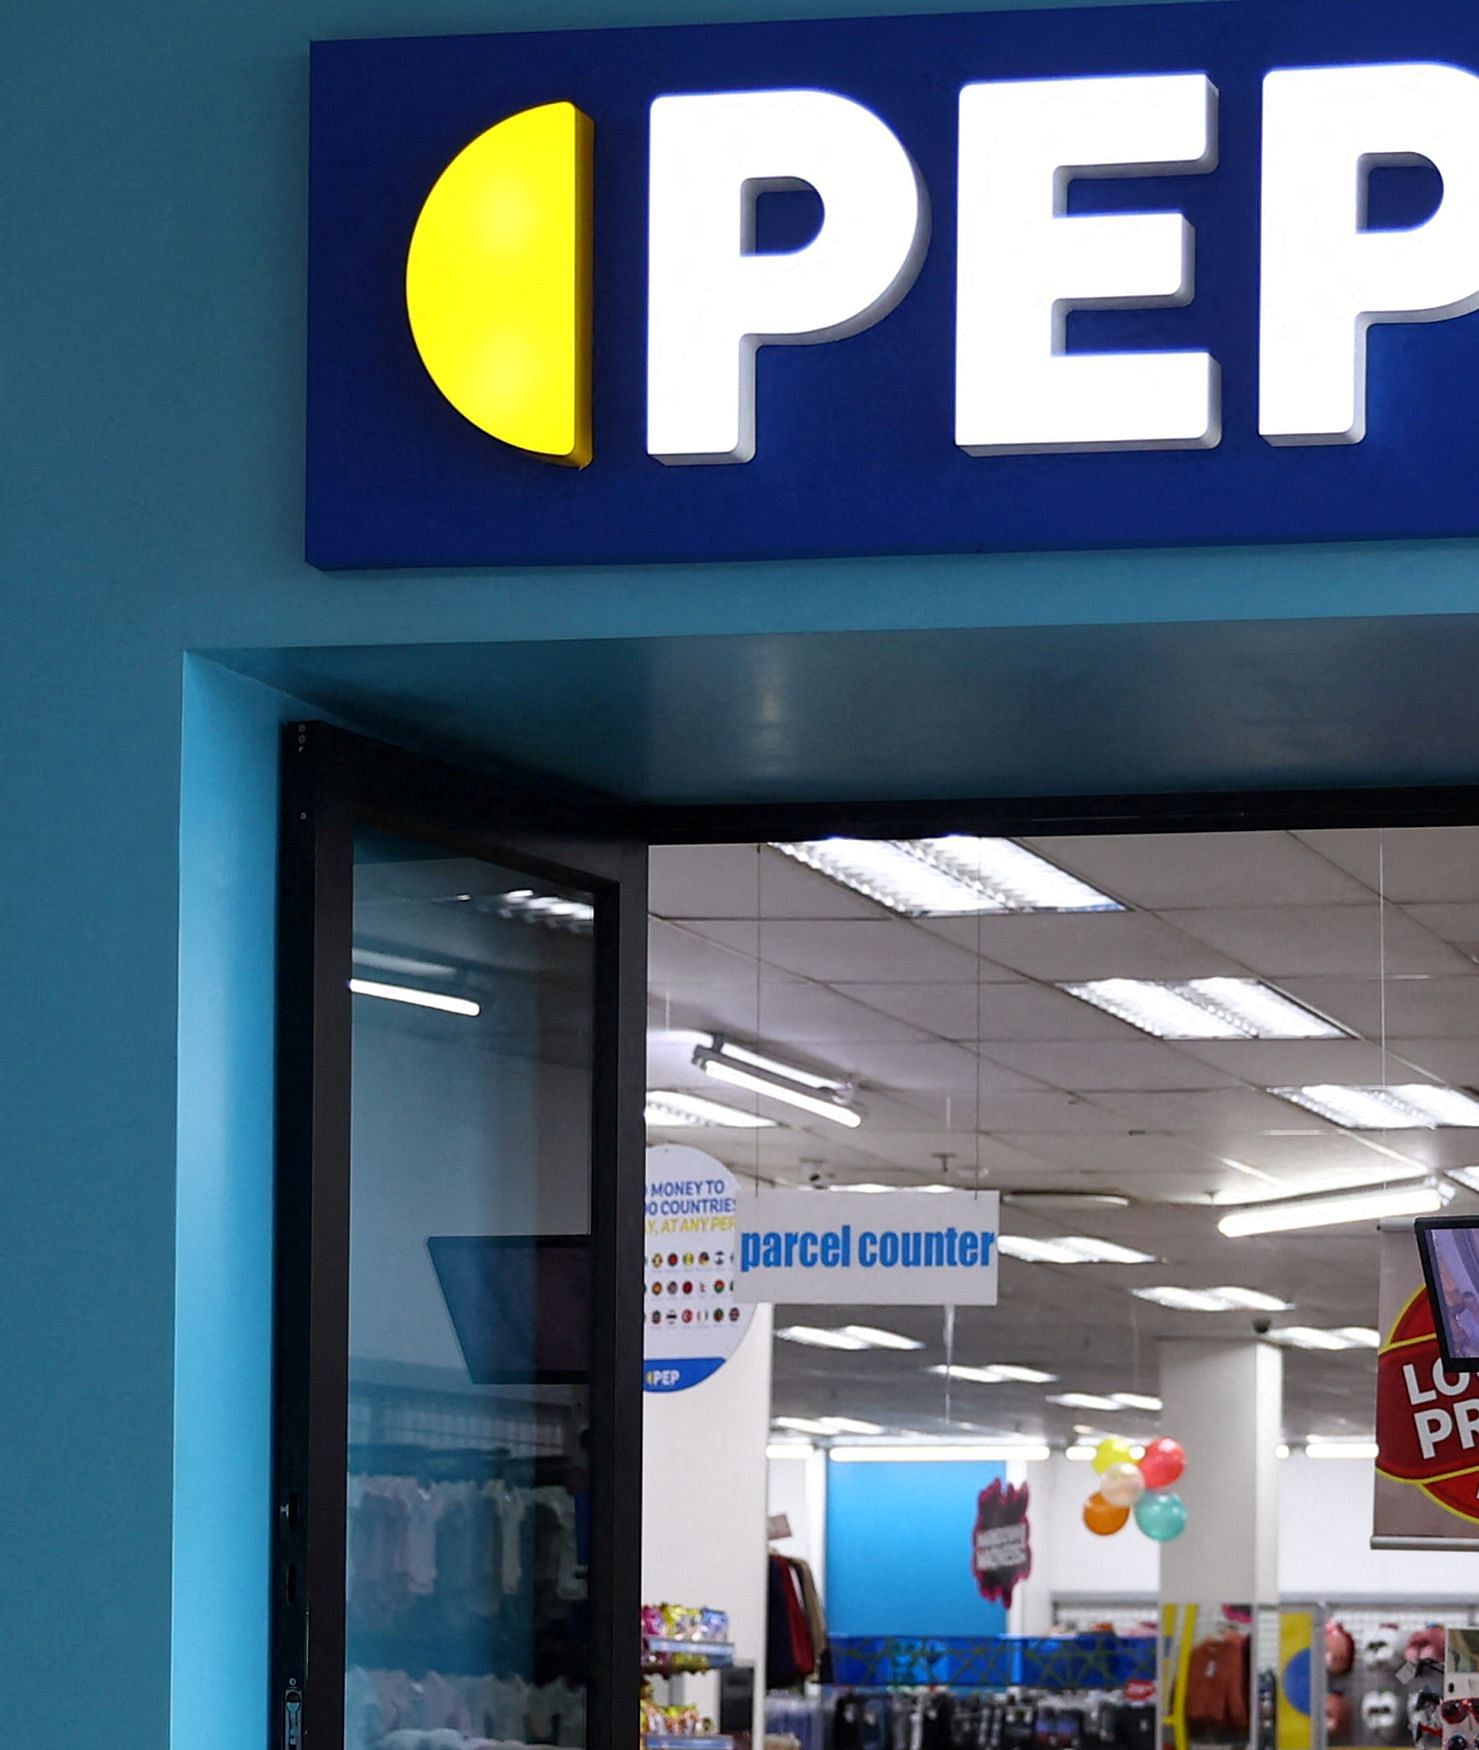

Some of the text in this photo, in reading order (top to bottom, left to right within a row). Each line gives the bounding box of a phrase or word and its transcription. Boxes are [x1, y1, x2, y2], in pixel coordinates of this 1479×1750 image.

[650, 1179, 725, 1197] MONEY TO
[740, 1225, 995, 1272] parcel counter
[652, 1369, 680, 1386] PEP
